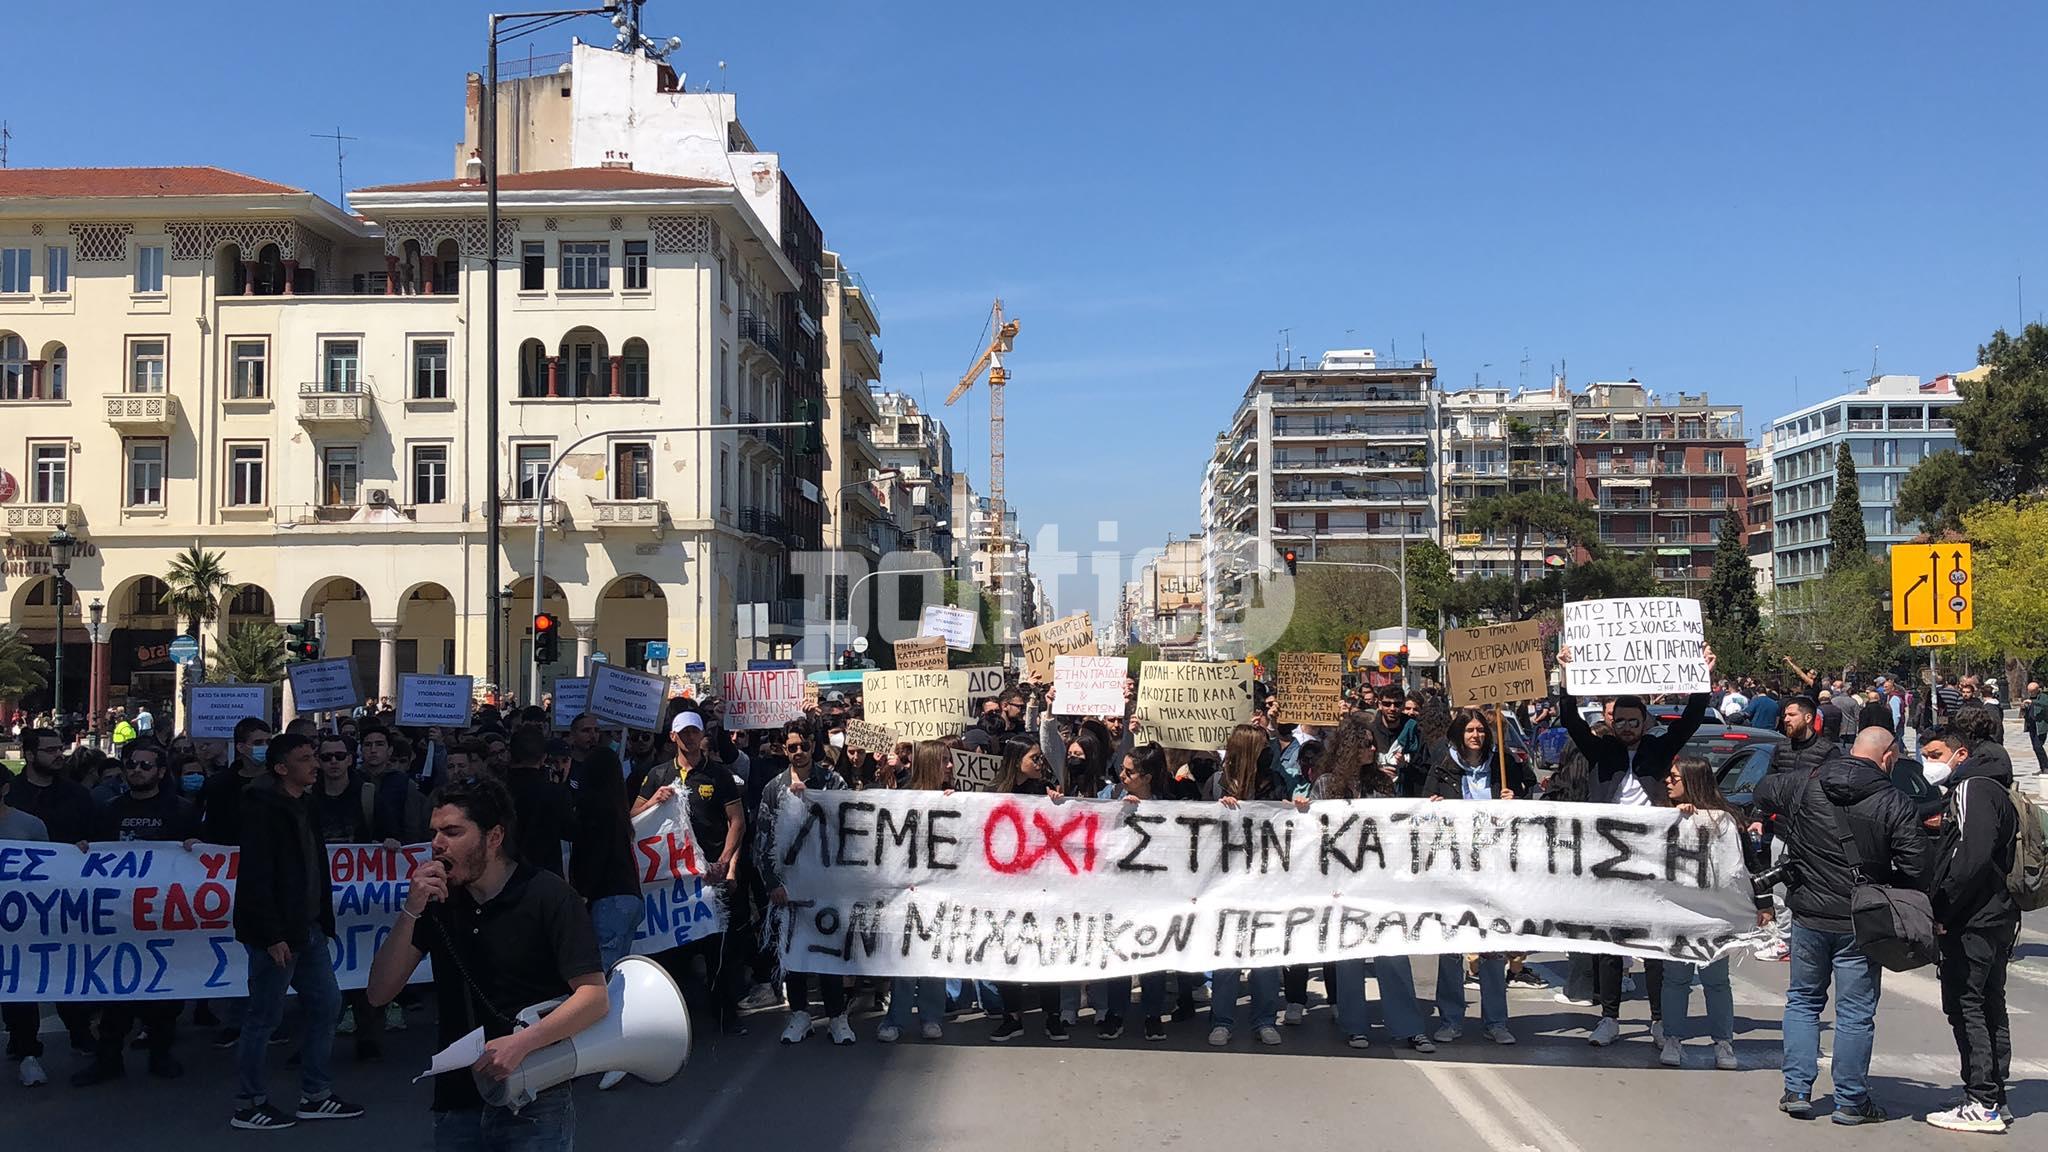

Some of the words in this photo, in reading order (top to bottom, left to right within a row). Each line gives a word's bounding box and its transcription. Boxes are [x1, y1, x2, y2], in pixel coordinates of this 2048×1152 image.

[1566, 603, 1604, 622] ΚΑΤΩ
[1613, 602, 1634, 619] ΤΑ
[1639, 601, 1682, 618] ΧΕΡΙΑ
[1022, 632, 1041, 647] ΜΗΝ
[1044, 615, 1092, 640] ΚΑΤΑΡΓΕΙΤΕ
[1465, 629, 1480, 638] ΤΟ
[1488, 625, 1518, 637] ΤΜΗΜΑ
[1567, 624, 1591, 640] ΑΠΟ
[1598, 621, 1626, 637] ΤΙΣ
[1629, 620, 1680, 635] ΣΧΟΛΕΣ
[1683, 621, 1704, 635] ΜΑΣ
[896, 641, 919, 650] ΜΗΝ
[897, 646, 946, 660] ΚΑΤΑΡΓΕΙΤΕ
[1025, 647, 1044, 663] ΤΟ
[1048, 630, 1094, 658] ΜΕΛΛΟΝ
[1624, 640, 1653, 661] ΔΕΝ
[898, 661, 909, 669] ΤΟ
[911, 658, 944, 668] ΜΕΛΛΟΝ
[1070, 657, 1112, 668] ΤΕΛΟΣ
[1280, 654, 1325, 663] ΘΕΛΟΥΝΕ
[1055, 669, 1088, 680] ΣΤΗΝ
[1144, 666, 1169, 680] ΚΟΥΛΗ
[1177, 665, 1240, 681] ΚΕΡΑΜΕΩΣ
[1303, 664, 1341, 672] ΦΟΙΤΗΤΕΣ
[1471, 662, 1496, 678] ΔΕΝ
[1498, 658, 1530, 673] ΒΓΑΙΝΕΙ
[1571, 669, 1601, 685] ΤΙΣ
[1606, 664, 1676, 685] ΣΠΟΥΔΕΣ
[1678, 663, 1709, 683] ΜΑΣ
[867, 676, 888, 691] ΟΧΙ
[896, 674, 949, 689] ΜΕΤΑΦΟΡΑ
[1065, 681, 1088, 690] ΤΩΝ
[1092, 681, 1124, 689] ΛΙΓΩΝ
[1278, 677, 1339, 686] ΠΕΙΡΑΜΑΤΩΝ
[1297, 685, 1310, 693] ΘΑ
[1468, 685, 1498, 700] ΣΤΟ
[1504, 679, 1534, 696] ΣΦΥΡΙ
[1140, 686, 1184, 702] ΑΚΟΥΣΤΕ
[1188, 687, 1198, 703] ΤΟ
[1203, 687, 1236, 702] ΚΑΛΑ
[1278, 694, 1339, 702] ΕΠΙΤΡΕΨΟΥΜΕ
[729, 702, 746, 714] ΔΕΝ
[868, 700, 887, 714] ΟΧΙ
[895, 698, 966, 717] ΚΑΤΑΡΓΗΣΗ
[1066, 704, 1116, 714] ΕΚΛΕΚΤΩΝ
[1137, 707, 1150, 721] ΟΙ
[1159, 707, 1236, 721] ΜΗΧΑΝΙΚΟΙ
[850, 720, 871, 730] ΛΕΝΕ
[874, 725, 887, 734] ΓΙΑ
[1139, 725, 1163, 743] ΔΕΝ
[1168, 726, 1195, 742] ΠΑΜΕ
[1198, 726, 1236, 743] ΠΟΥΘΕ
[784, 801, 962, 869] ΛΕΜΕ
[983, 798, 1099, 875] ΟΧΙ
[1117, 814, 1294, 874] ΣΤΗΝ
[1319, 811, 1710, 889] ΚΑΤΑΡΓΗΣΗ
[81, 850, 154, 879] ΚΑΙ
[132, 882, 230, 931] ΕΔΩ
[781, 900, 884, 962] ΤΩΝ
[902, 901, 1198, 969] ΜΗΧΑΝΙΚΩΝ
